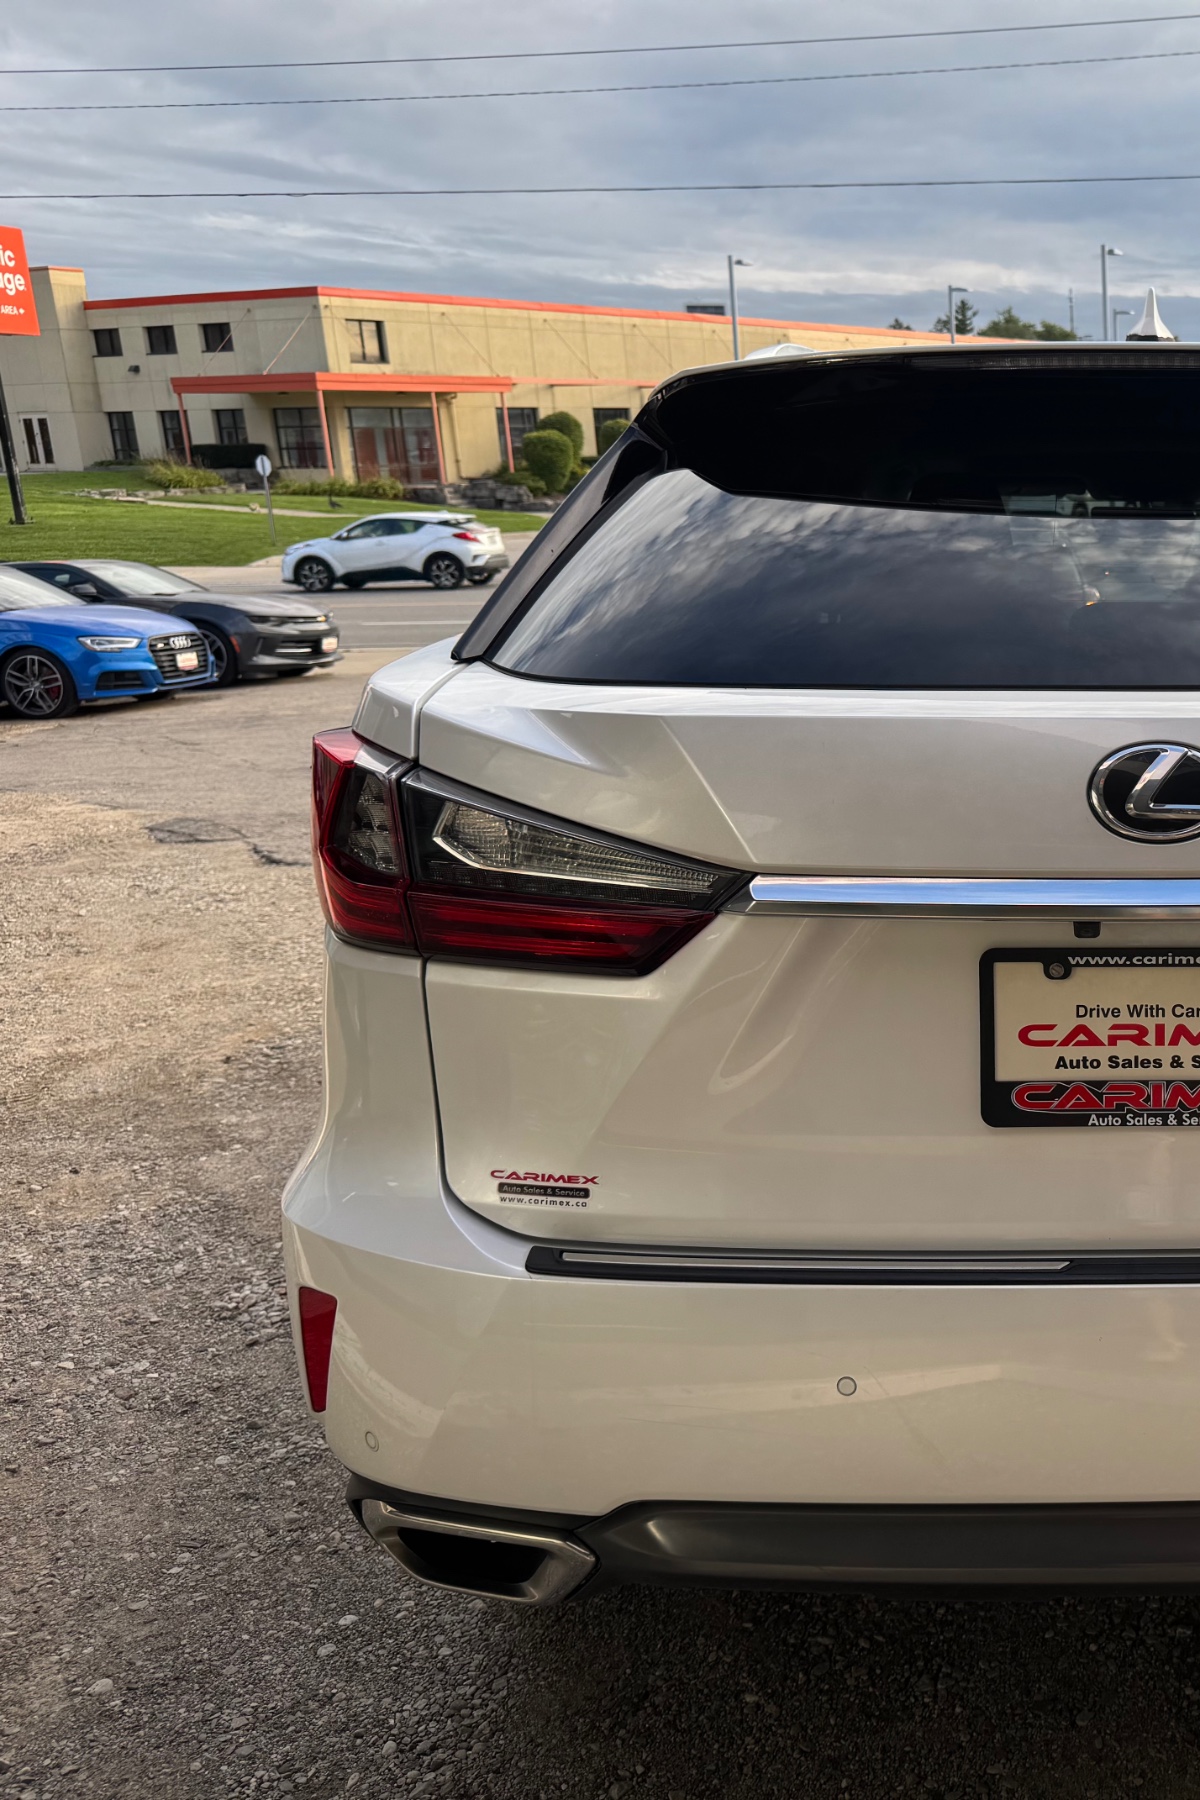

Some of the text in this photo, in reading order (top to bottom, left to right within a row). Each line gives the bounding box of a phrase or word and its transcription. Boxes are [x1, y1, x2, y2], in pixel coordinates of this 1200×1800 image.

[0, 304, 19, 315] AREA
[1075, 1003, 1122, 1019] Drive
[1126, 1003, 1166, 1019] With
[1054, 1055, 1102, 1070] Auto
[1107, 1055, 1164, 1070] Sales
[1169, 1055, 1185, 1069] &
[1087, 1113, 1121, 1127] Auto
[1126, 1113, 1165, 1127] Sales
[1167, 1114, 1179, 1126] &
[490, 1169, 600, 1185] CARIMEX
[502, 1184, 585, 1197] Auto Sales & Service
[500, 1196, 588, 1208] www.carimex.ca
